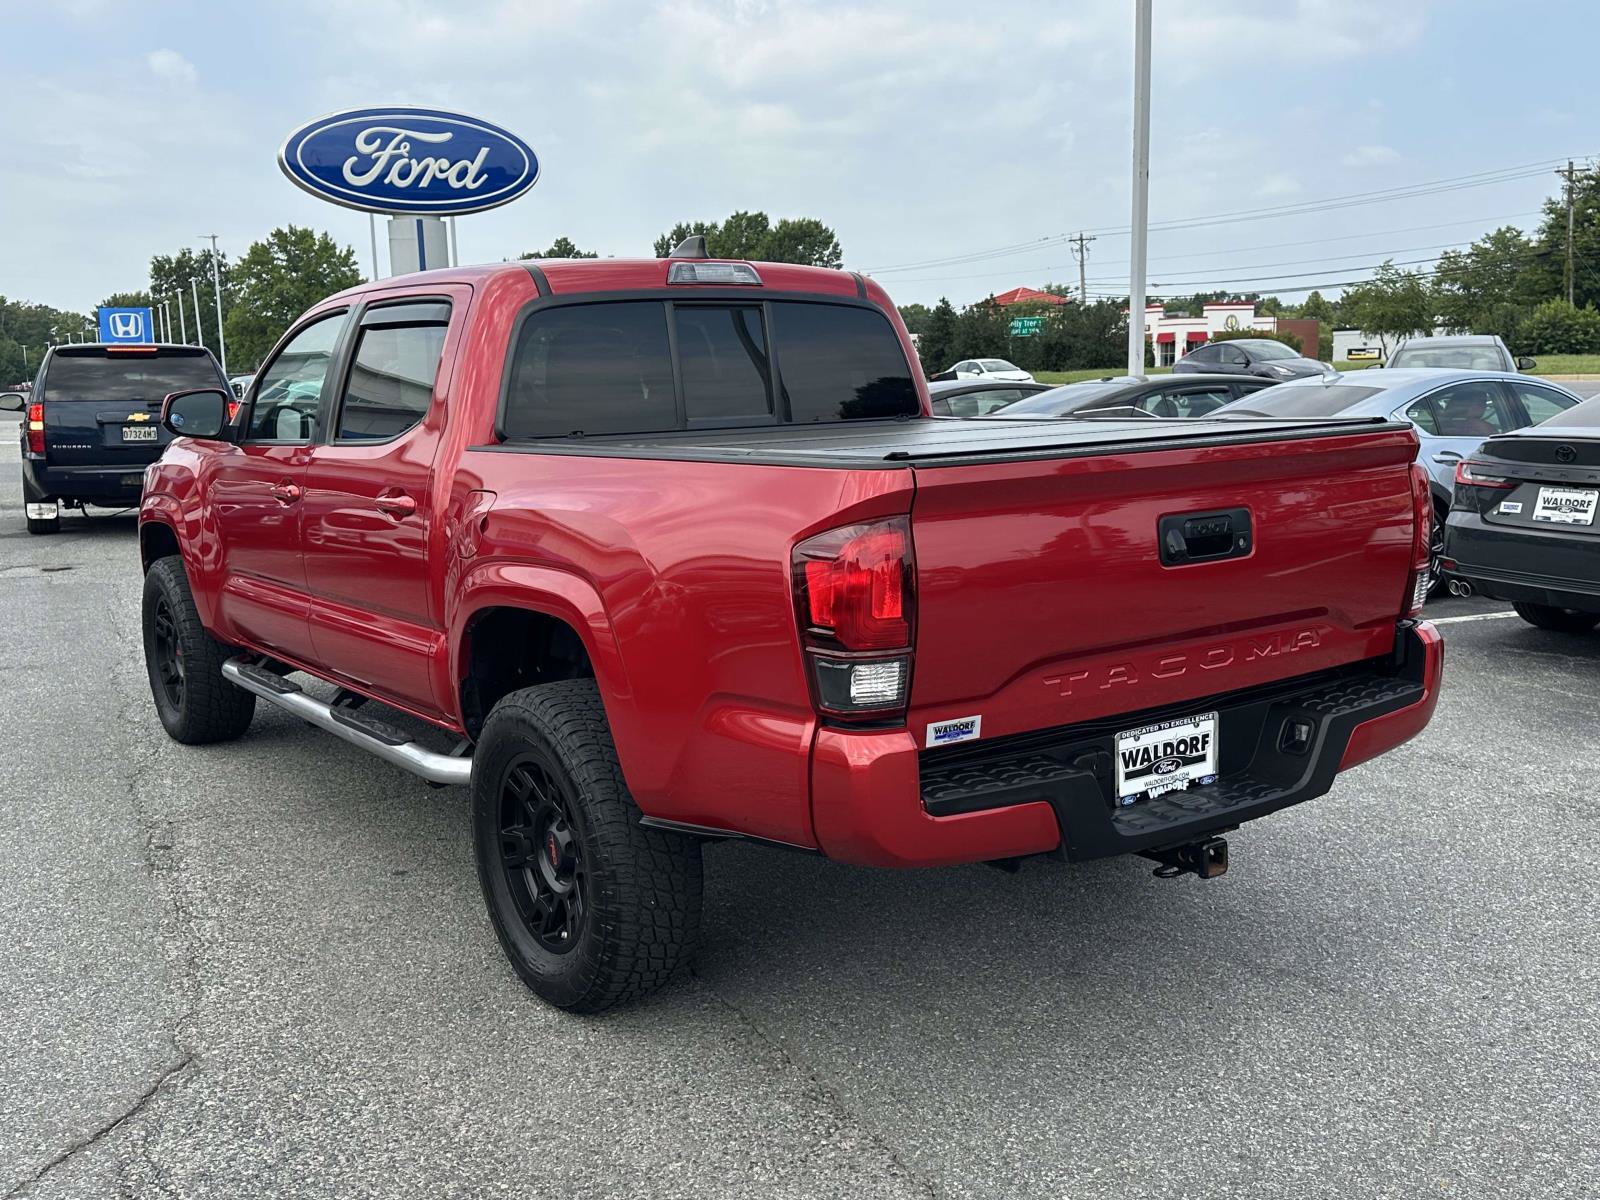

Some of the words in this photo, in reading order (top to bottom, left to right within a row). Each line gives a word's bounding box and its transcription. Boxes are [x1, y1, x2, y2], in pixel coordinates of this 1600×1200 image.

[342, 126, 490, 189] Ford
[1543, 496, 1592, 509] WALDORF
[1043, 629, 1321, 697] TACOMA
[933, 720, 975, 735] WALDORF
[1121, 724, 1159, 739] DEDICATED
[1160, 721, 1170, 730] TO
[1171, 713, 1213, 728] EXCELLENCE
[1121, 733, 1210, 770] WALDORF
[1158, 761, 1177, 774] Ford
[1147, 778, 1190, 799] WALDORF
